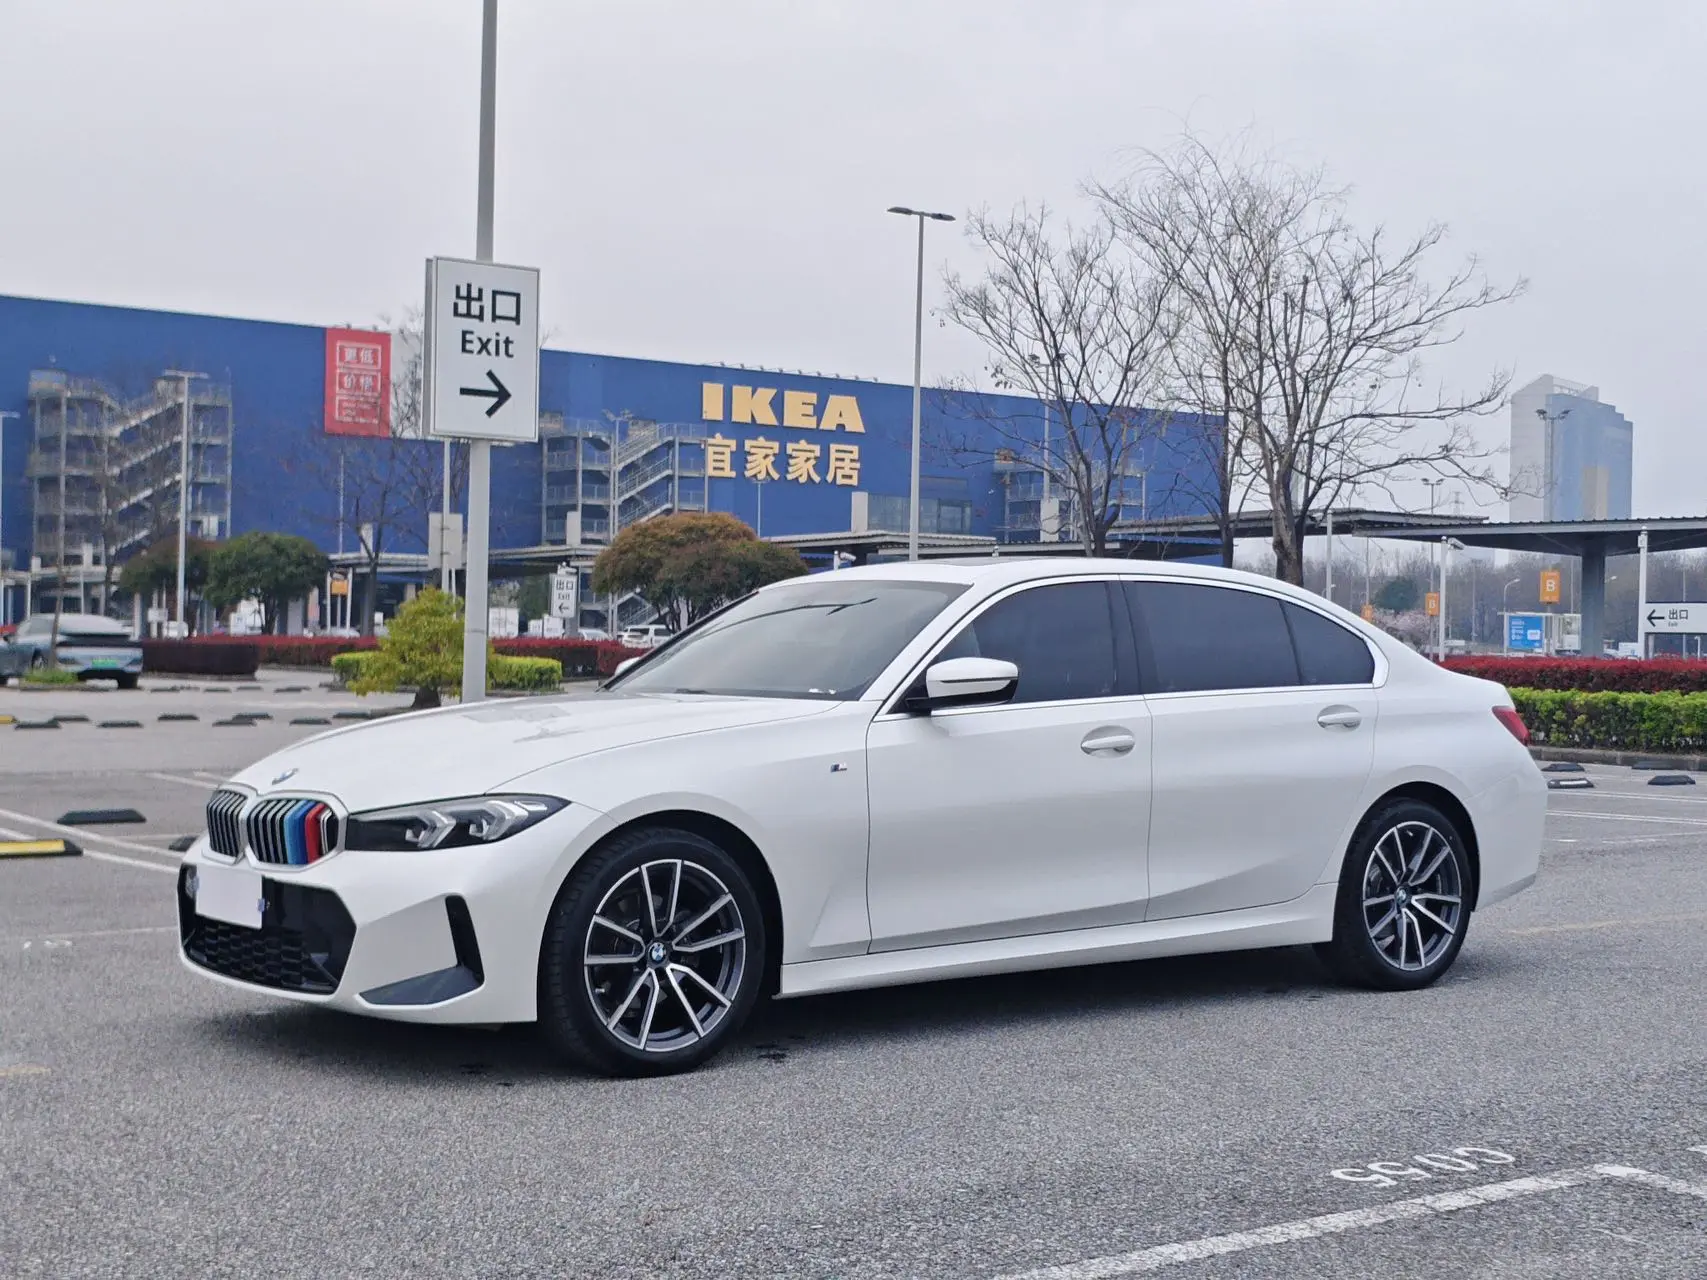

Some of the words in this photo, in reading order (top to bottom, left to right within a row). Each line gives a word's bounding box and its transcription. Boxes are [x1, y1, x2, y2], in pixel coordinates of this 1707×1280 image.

[453, 283, 521, 326] 出口
[461, 329, 514, 358] Exit
[702, 382, 866, 433] IKEA
[706, 433, 861, 486] 宜家家居
[1668, 608, 1688, 620] 出口
[1330, 1147, 1516, 1188] C055
